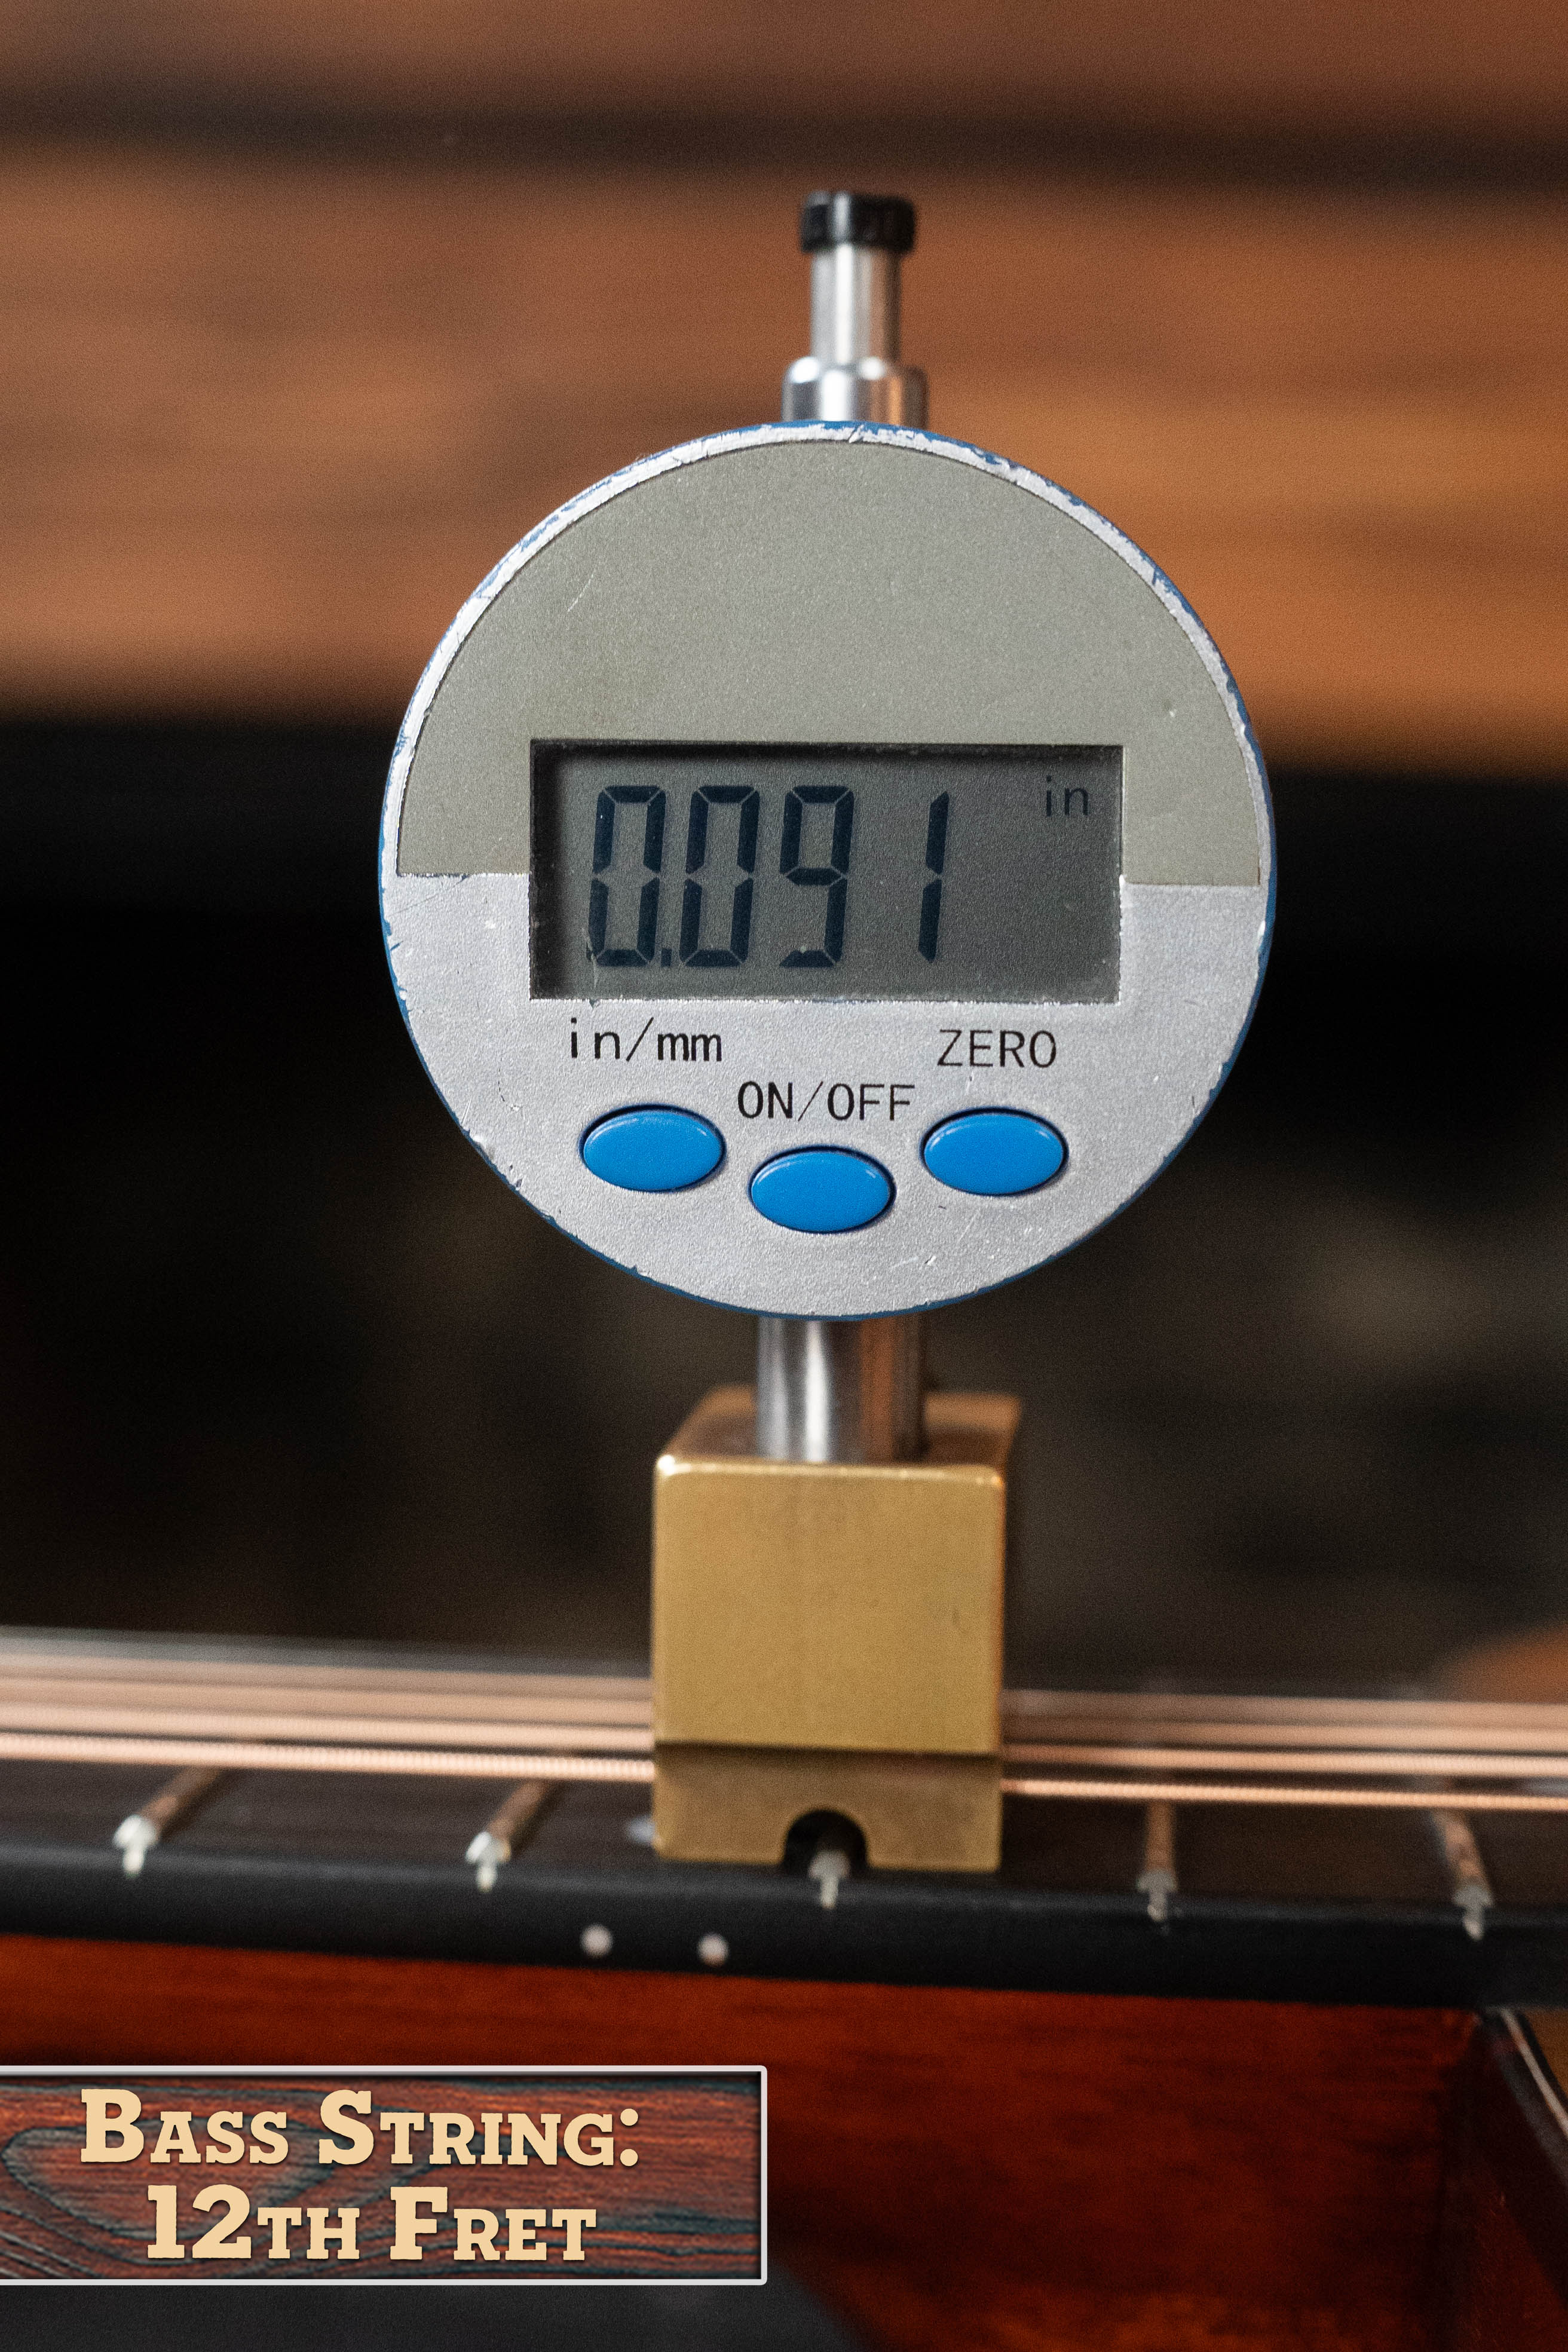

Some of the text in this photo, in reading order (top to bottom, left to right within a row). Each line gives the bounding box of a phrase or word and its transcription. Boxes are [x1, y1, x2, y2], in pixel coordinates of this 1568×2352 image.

[1045, 774, 1090, 817] in
[586, 784, 950, 967] 0.091
[569, 1016, 723, 1062] in/mm
[936, 1028, 1058, 1069] ZERO
[737, 1080, 916, 1121] ON/OFF
